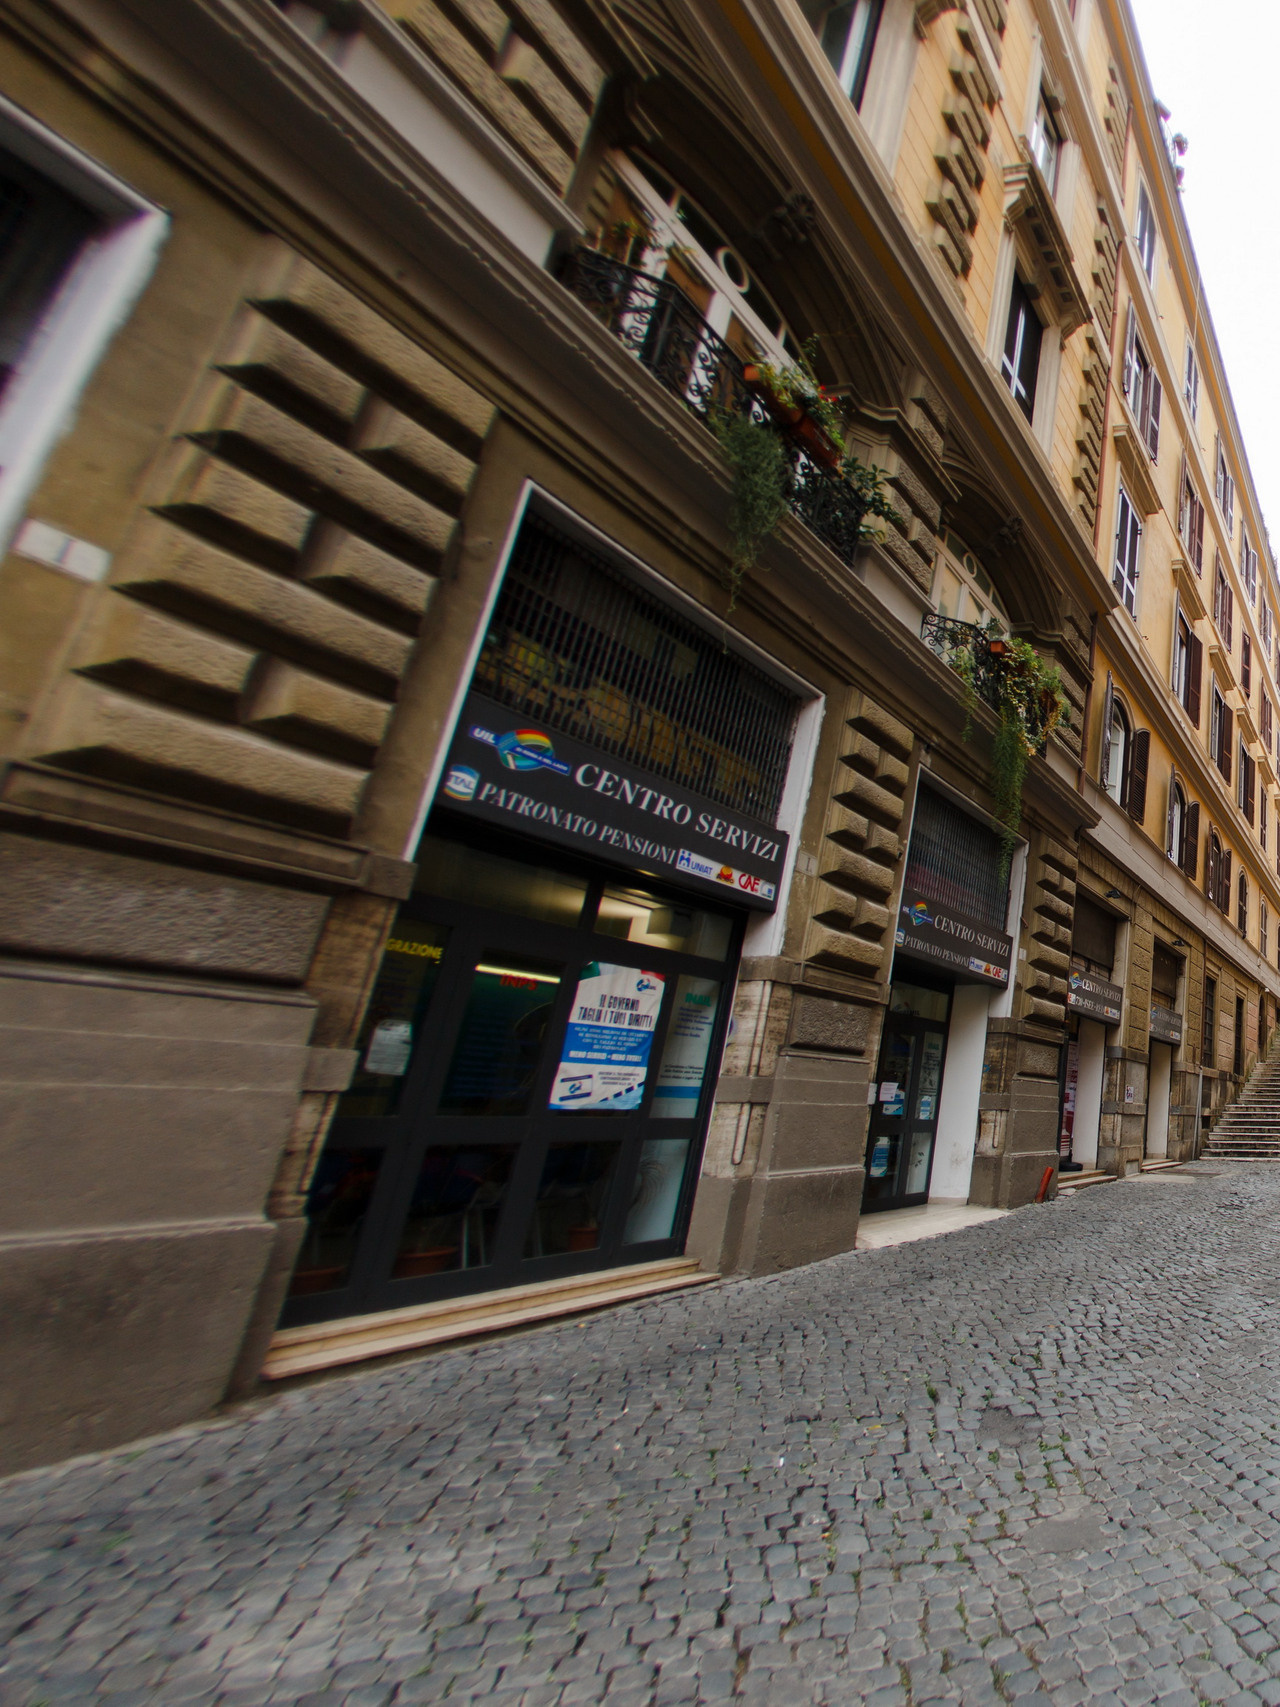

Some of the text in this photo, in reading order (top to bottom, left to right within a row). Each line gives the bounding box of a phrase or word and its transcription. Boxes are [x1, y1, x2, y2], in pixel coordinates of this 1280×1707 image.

[473, 727, 496, 744] UIL
[478, 782, 677, 865] PATRONATO PENSIONI
[574, 763, 780, 862] CENTRO SERVIZI
[691, 860, 714, 877] UNIAT
[904, 935, 970, 968] PATRONATO PENSIONI
[934, 914, 1010, 957] CENTRO SERVIZI
[608, 995, 640, 1012] GOVERNO
